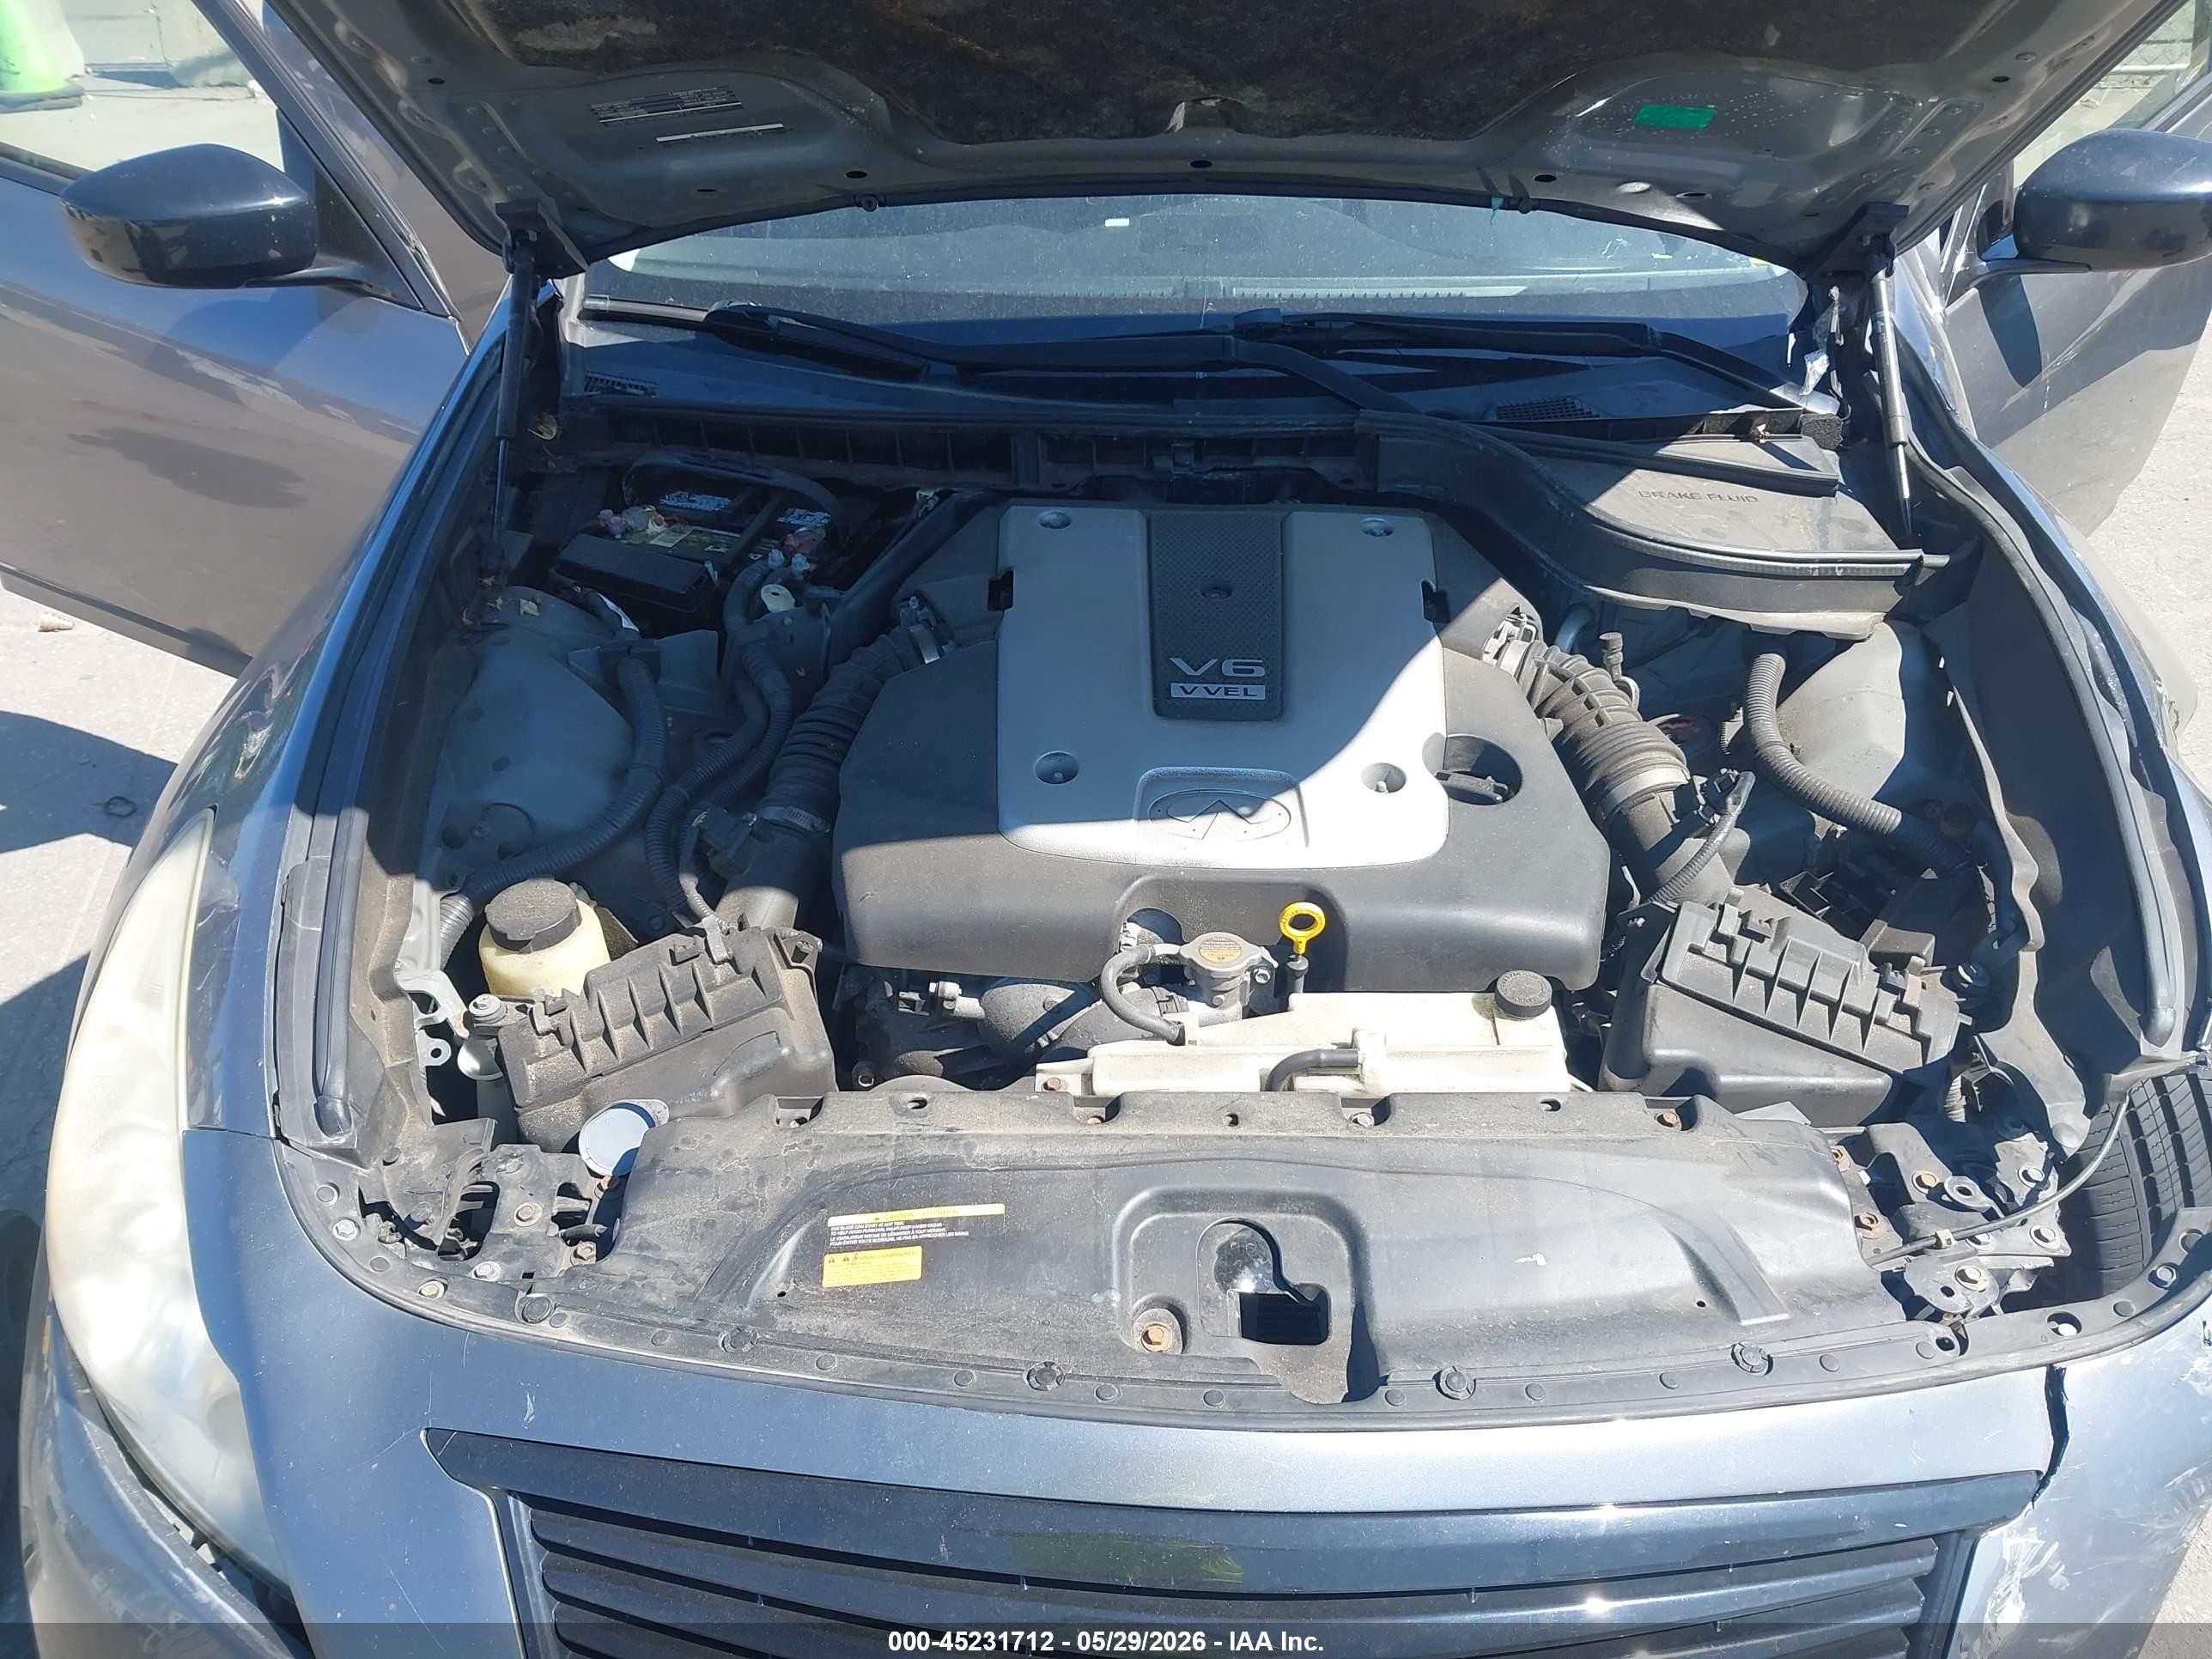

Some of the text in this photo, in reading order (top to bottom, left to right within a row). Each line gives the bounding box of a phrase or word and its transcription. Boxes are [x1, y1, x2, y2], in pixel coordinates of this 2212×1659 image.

[1638, 489, 1759, 504] BRAKE FLUID
[1169, 657, 1266, 678] V6
[1179, 685, 1258, 697] VVEL
